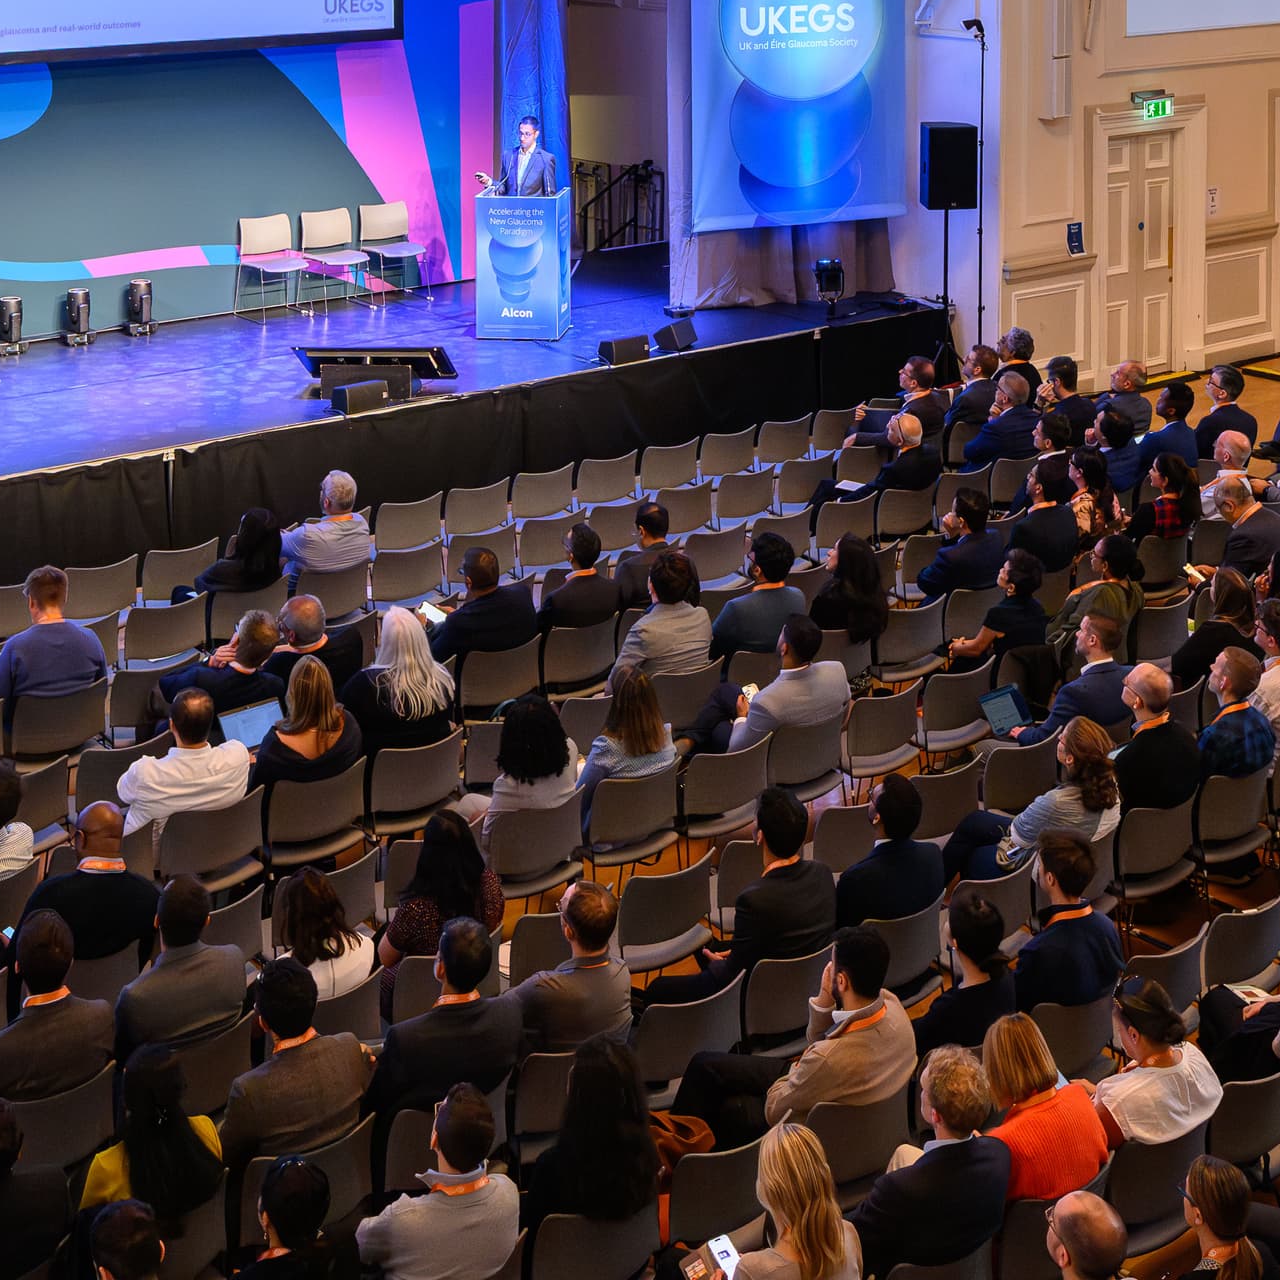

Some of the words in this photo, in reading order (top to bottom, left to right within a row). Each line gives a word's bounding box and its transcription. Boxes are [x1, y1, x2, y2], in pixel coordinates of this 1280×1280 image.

[740, 2, 855, 37] UKEGS
[739, 42, 751, 50] UK
[753, 41, 768, 49] and
[788, 40, 827, 48] Glaucoma
[830, 39, 858, 48] Society
[507, 218, 543, 226] Glaucoma
[501, 308, 533, 318] Alcon
